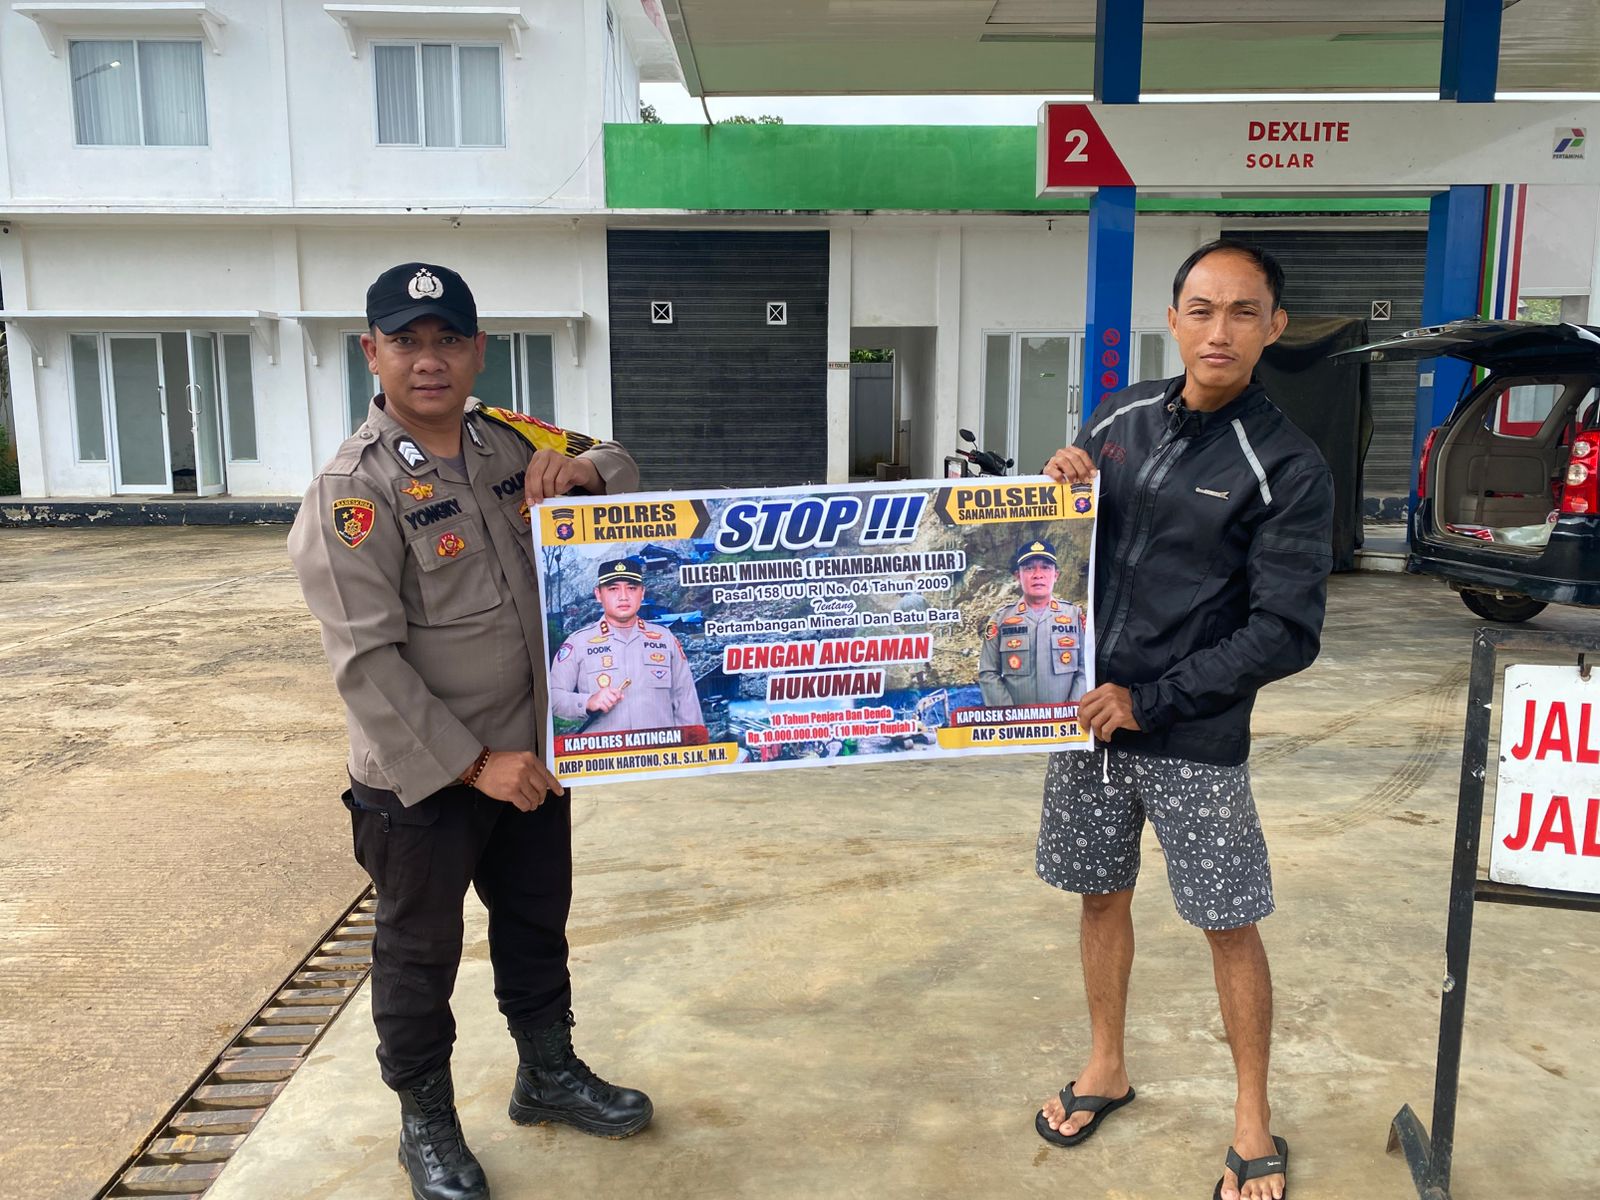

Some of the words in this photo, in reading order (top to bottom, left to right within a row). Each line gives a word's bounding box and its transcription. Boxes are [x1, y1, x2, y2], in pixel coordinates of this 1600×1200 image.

[1248, 121, 1350, 142] DEXLITE
[1063, 128, 1089, 163] 2
[1246, 153, 1314, 168] SOLAR
[957, 486, 1058, 509] POLSEK
[593, 503, 676, 525] POLRES
[719, 499, 859, 548] STOP
[864, 495, 926, 540] !!!
[958, 506, 1009, 521] SANAMAN
[1010, 505, 1058, 518] MANTIKEI
[594, 523, 677, 541] KATINGAN
[682, 566, 736, 585] ILLEGAL
[739, 562, 801, 582] MINNING
[815, 555, 921, 577] PENAMBANGAN
[925, 553, 955, 571] LIAR
[715, 588, 752, 602] Pasal
[756, 587, 780, 599] 158
[784, 585, 805, 598] UU
[808, 585, 822, 597] RI
[826, 583, 849, 596] No.
[852, 582, 868, 594] 04
[872, 580, 913, 593] Tahun
[917, 578, 948, 590] 2009
[813, 600, 855, 613] Tentang
[707, 617, 806, 636] Pertambangan
[810, 614, 859, 629] Mineral
[863, 612, 890, 626] Dan
[893, 611, 926, 623] Batu
[929, 609, 959, 622] Bara
[1052, 625, 1077, 633] POLRI
[587, 645, 612, 655] DODIK
[726, 643, 815, 671] DENGAN
[819, 637, 930, 665] ANCAMAN
[769, 671, 882, 701] HUKUMAN
[771, 714, 781, 726] 10
[783, 712, 810, 725] Tahun
[811, 710, 844, 724] Penjara
[845, 708, 862, 721] Dan
[864, 707, 892, 720] Denda
[956, 709, 1005, 724] KAPOLSEK
[1006, 707, 1052, 722] SANAMAN
[1053, 705, 1079, 718] MANT
[564, 735, 624, 752] KAPOLRES
[625, 730, 682, 747] KATINGAN
[748, 731, 761, 744] Rp.
[841, 725, 850, 736] 10
[852, 723, 879, 736] Milyar
[880, 721, 911, 735] Rupiah
[972, 727, 997, 741] AKP
[999, 725, 1057, 741] SUWARDI,
[1060, 724, 1081, 737] S.H.
[559, 760, 584, 775] AKBP
[585, 758, 614, 773] DODIK
[616, 754, 662, 770] HARTONO,
[708, 748, 728, 762] M.H.
